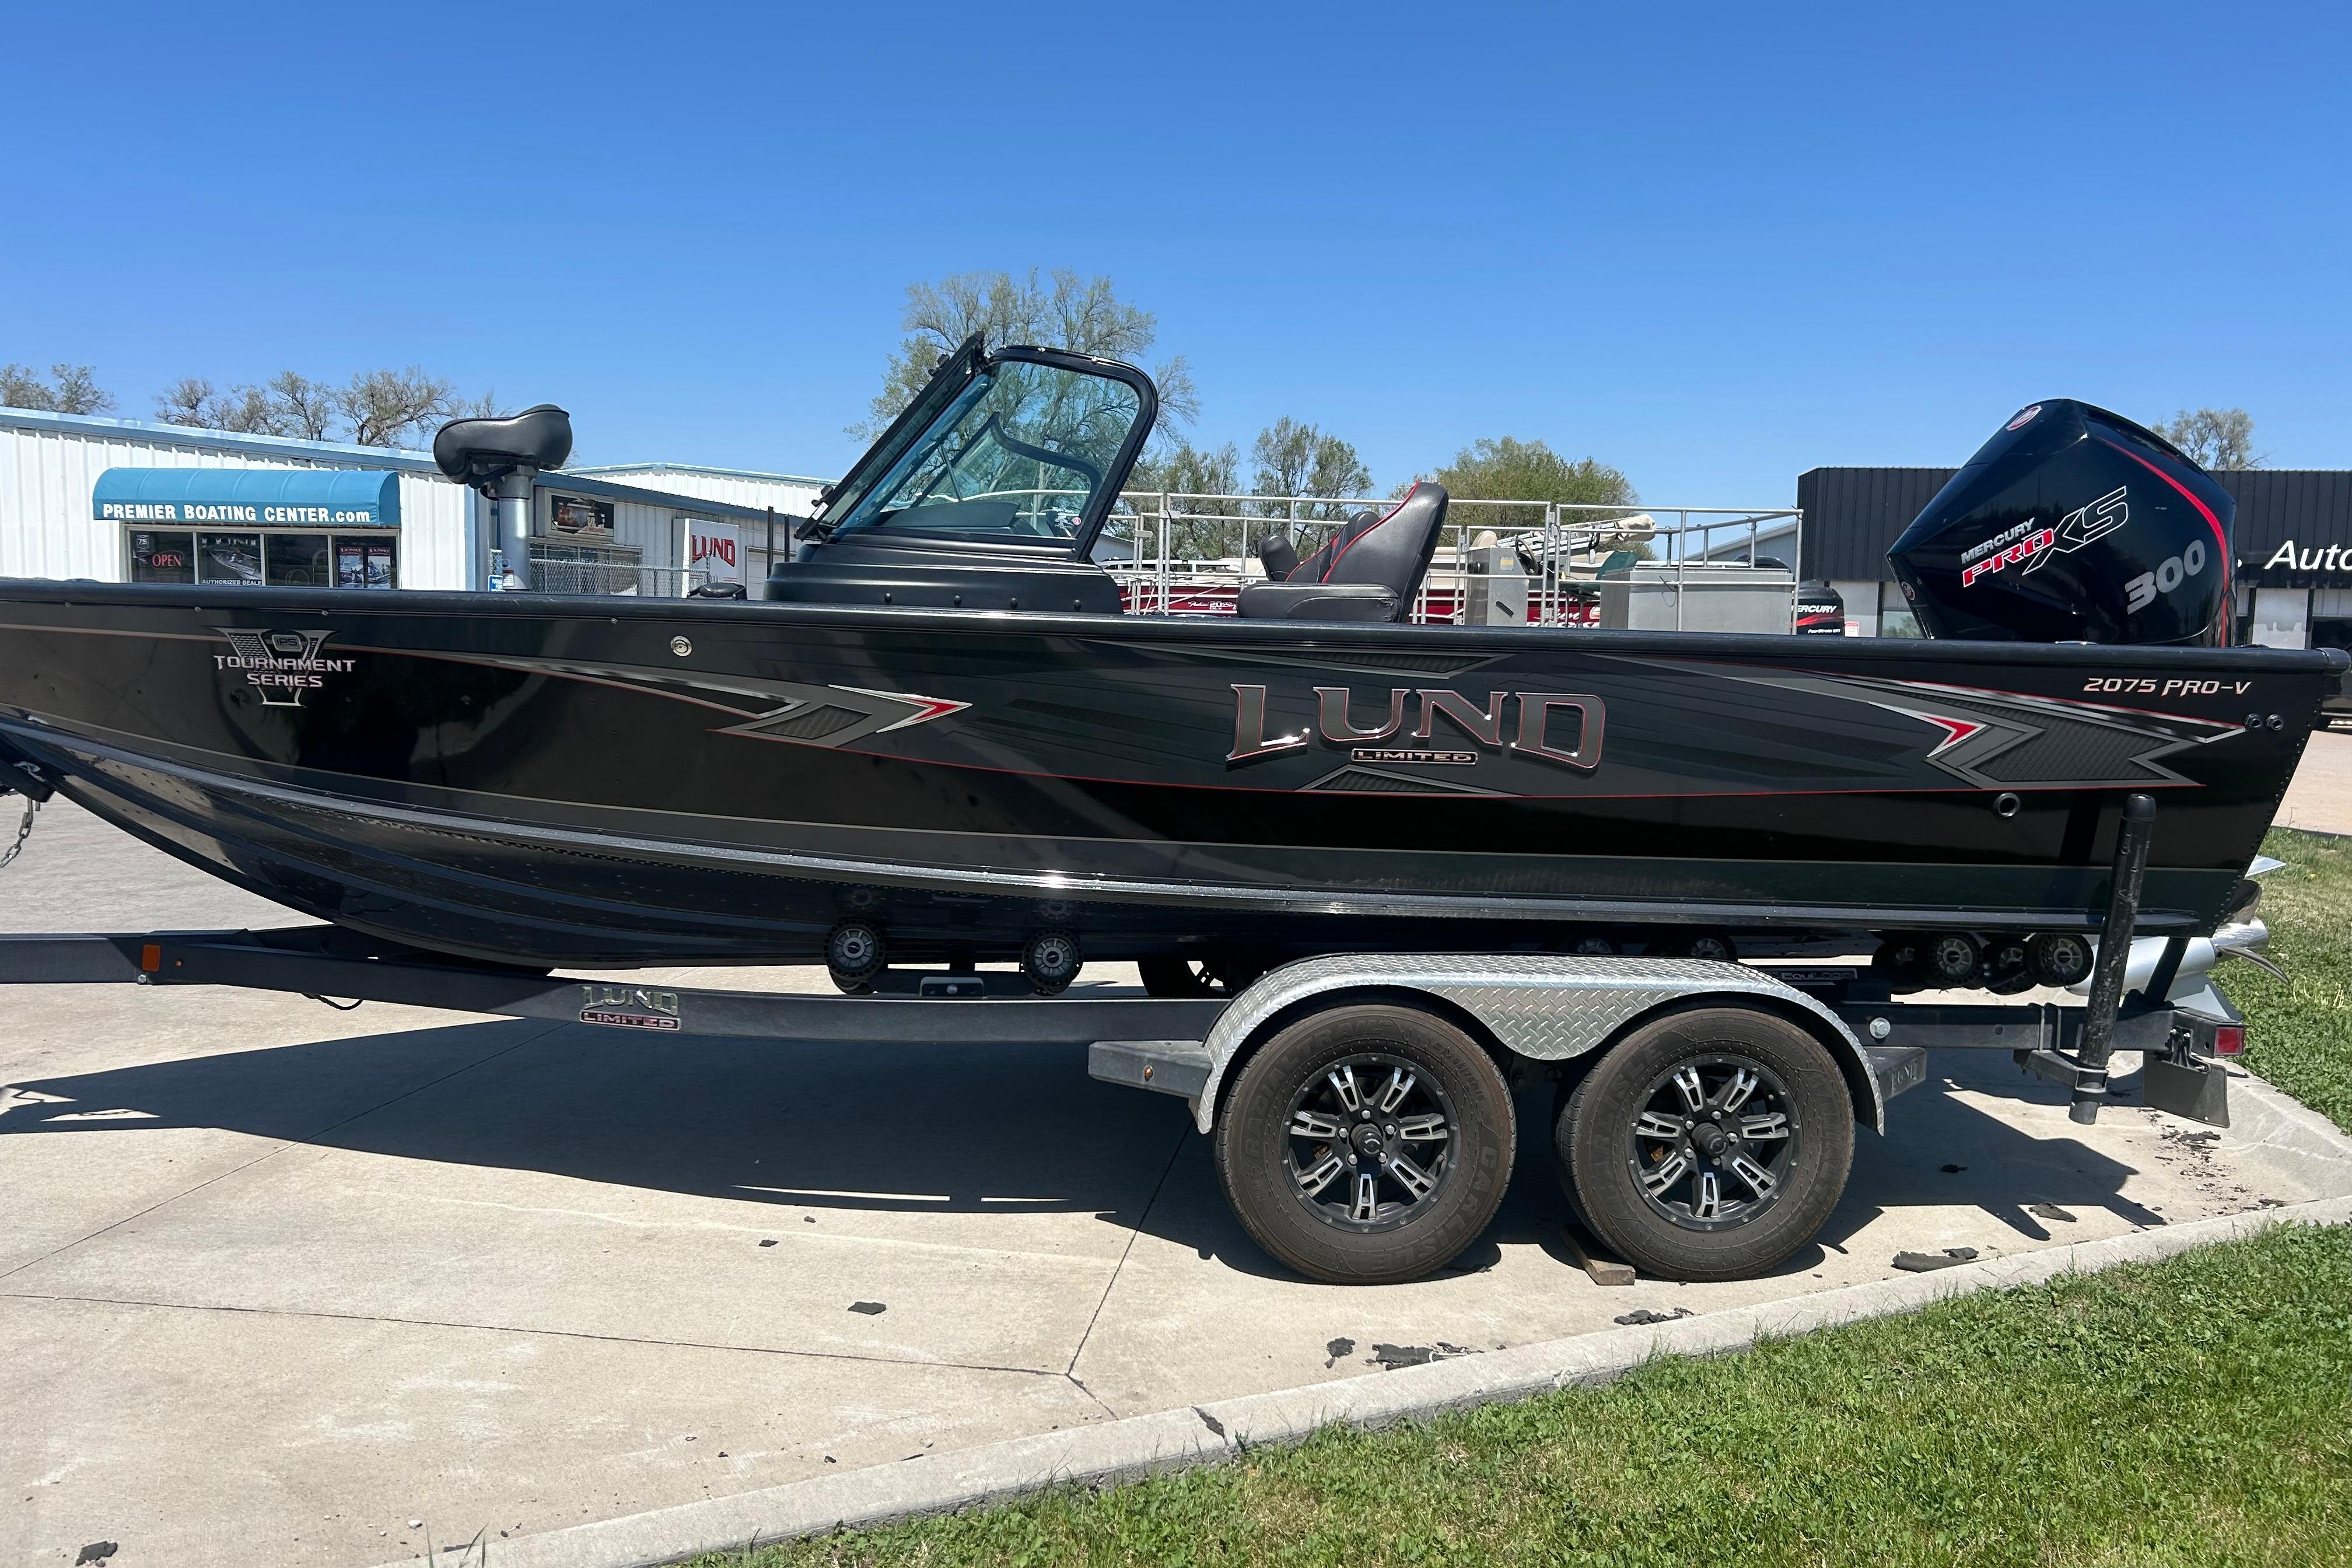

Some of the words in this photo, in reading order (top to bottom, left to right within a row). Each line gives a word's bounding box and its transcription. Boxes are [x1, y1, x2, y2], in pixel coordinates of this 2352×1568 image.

[103, 503, 176, 519] PREMIER
[184, 505, 256, 521] BOATING
[264, 506, 371, 523] CENTER.com
[691, 534, 736, 568] LUND
[1961, 517, 2035, 564] MERCURY
[152, 554, 181, 566] OPEN
[2124, 539, 2206, 615] 300
[213, 655, 356, 672] TOURNAMENT
[247, 673, 323, 687] SERIES
[2082, 678, 2157, 693] 2075
[2161, 680, 2252, 696] PRO-V
[1226, 684, 1606, 769] LUND
[1357, 751, 1472, 763] LIMITED
[582, 986, 678, 1016] LUND
[584, 1013, 676, 1027] LIMITED
[1244, 1056, 1299, 1158] RADIAL
[1296, 1019, 1384, 1056] TRAIL
[1594, 1040, 1662, 1206] CARLISLE
[1371, 1146, 1498, 1270] CARLISLE
